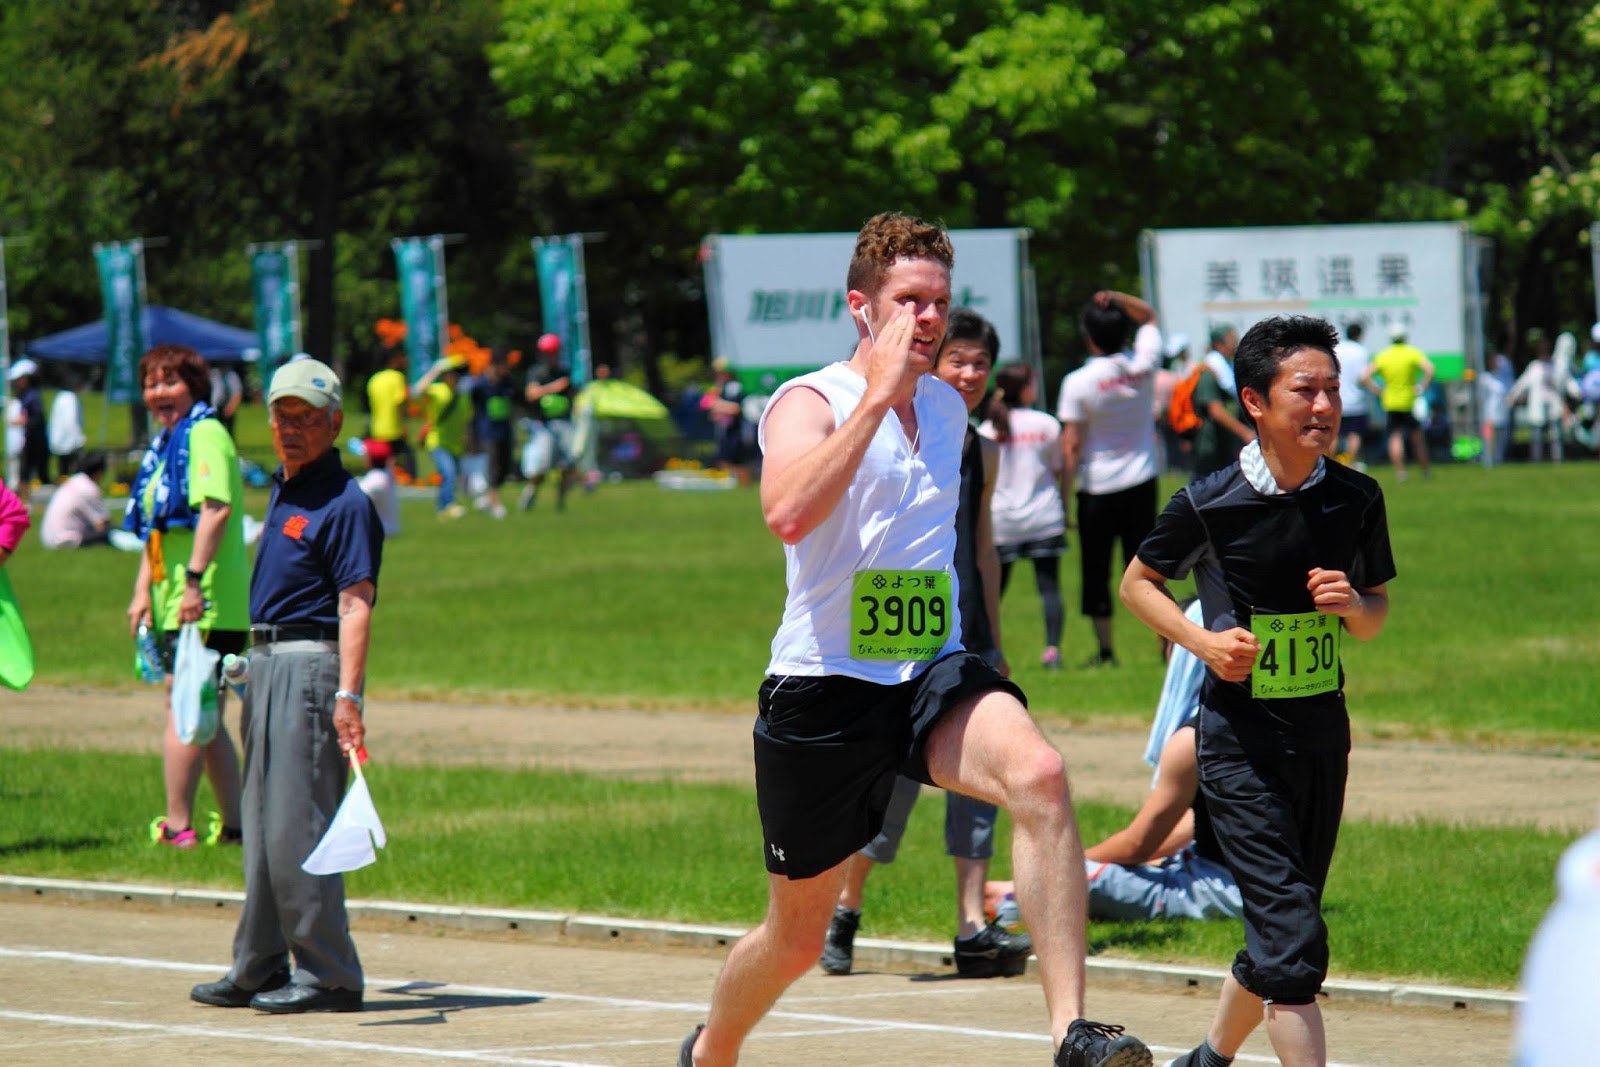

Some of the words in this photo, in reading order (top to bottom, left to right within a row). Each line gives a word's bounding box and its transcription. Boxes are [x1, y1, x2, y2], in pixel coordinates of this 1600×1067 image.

[892, 575, 936, 589] よつ葉
[859, 595, 945, 636] 3909
[1260, 633, 1334, 676] 4130
